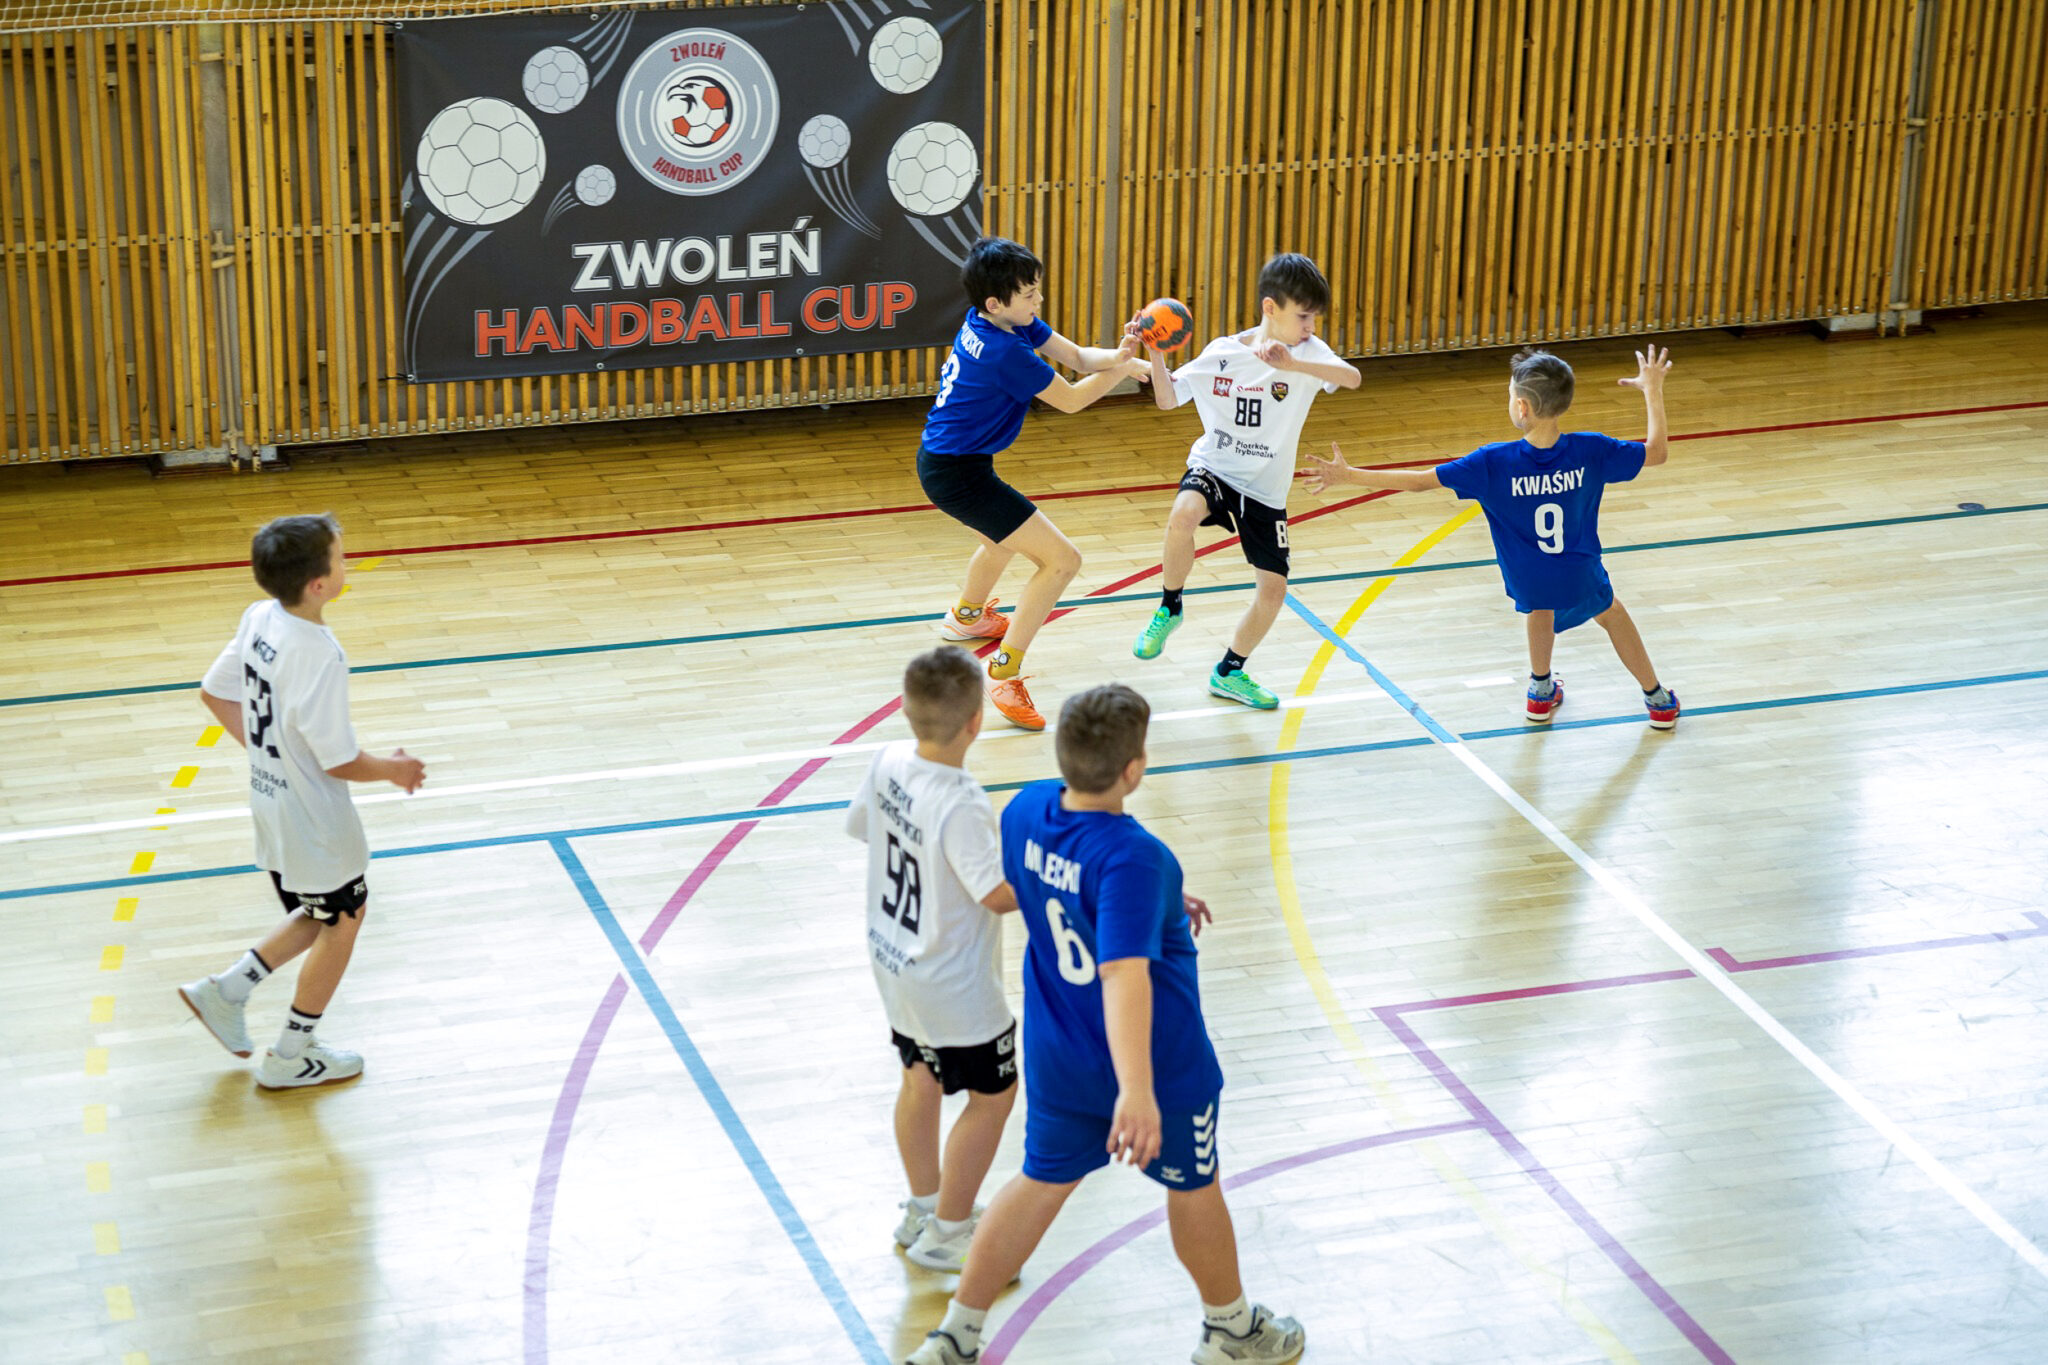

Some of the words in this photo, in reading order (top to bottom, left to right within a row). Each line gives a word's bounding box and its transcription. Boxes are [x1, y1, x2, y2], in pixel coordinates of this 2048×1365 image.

[670, 42, 726, 62] ZWOLEŃ
[652, 157, 718, 184] HANDBALL
[719, 152, 744, 177] CUP
[571, 216, 821, 292] ZWOLEŃ
[474, 290, 792, 357] HANDBALL
[801, 281, 917, 334] CUP
[1234, 396, 1262, 428] 88
[1236, 440, 1270, 451] Piotrków
[1511, 466, 1585, 497] KWAŚNY
[1534, 503, 1565, 554] 9
[1045, 897, 1096, 986] 6
